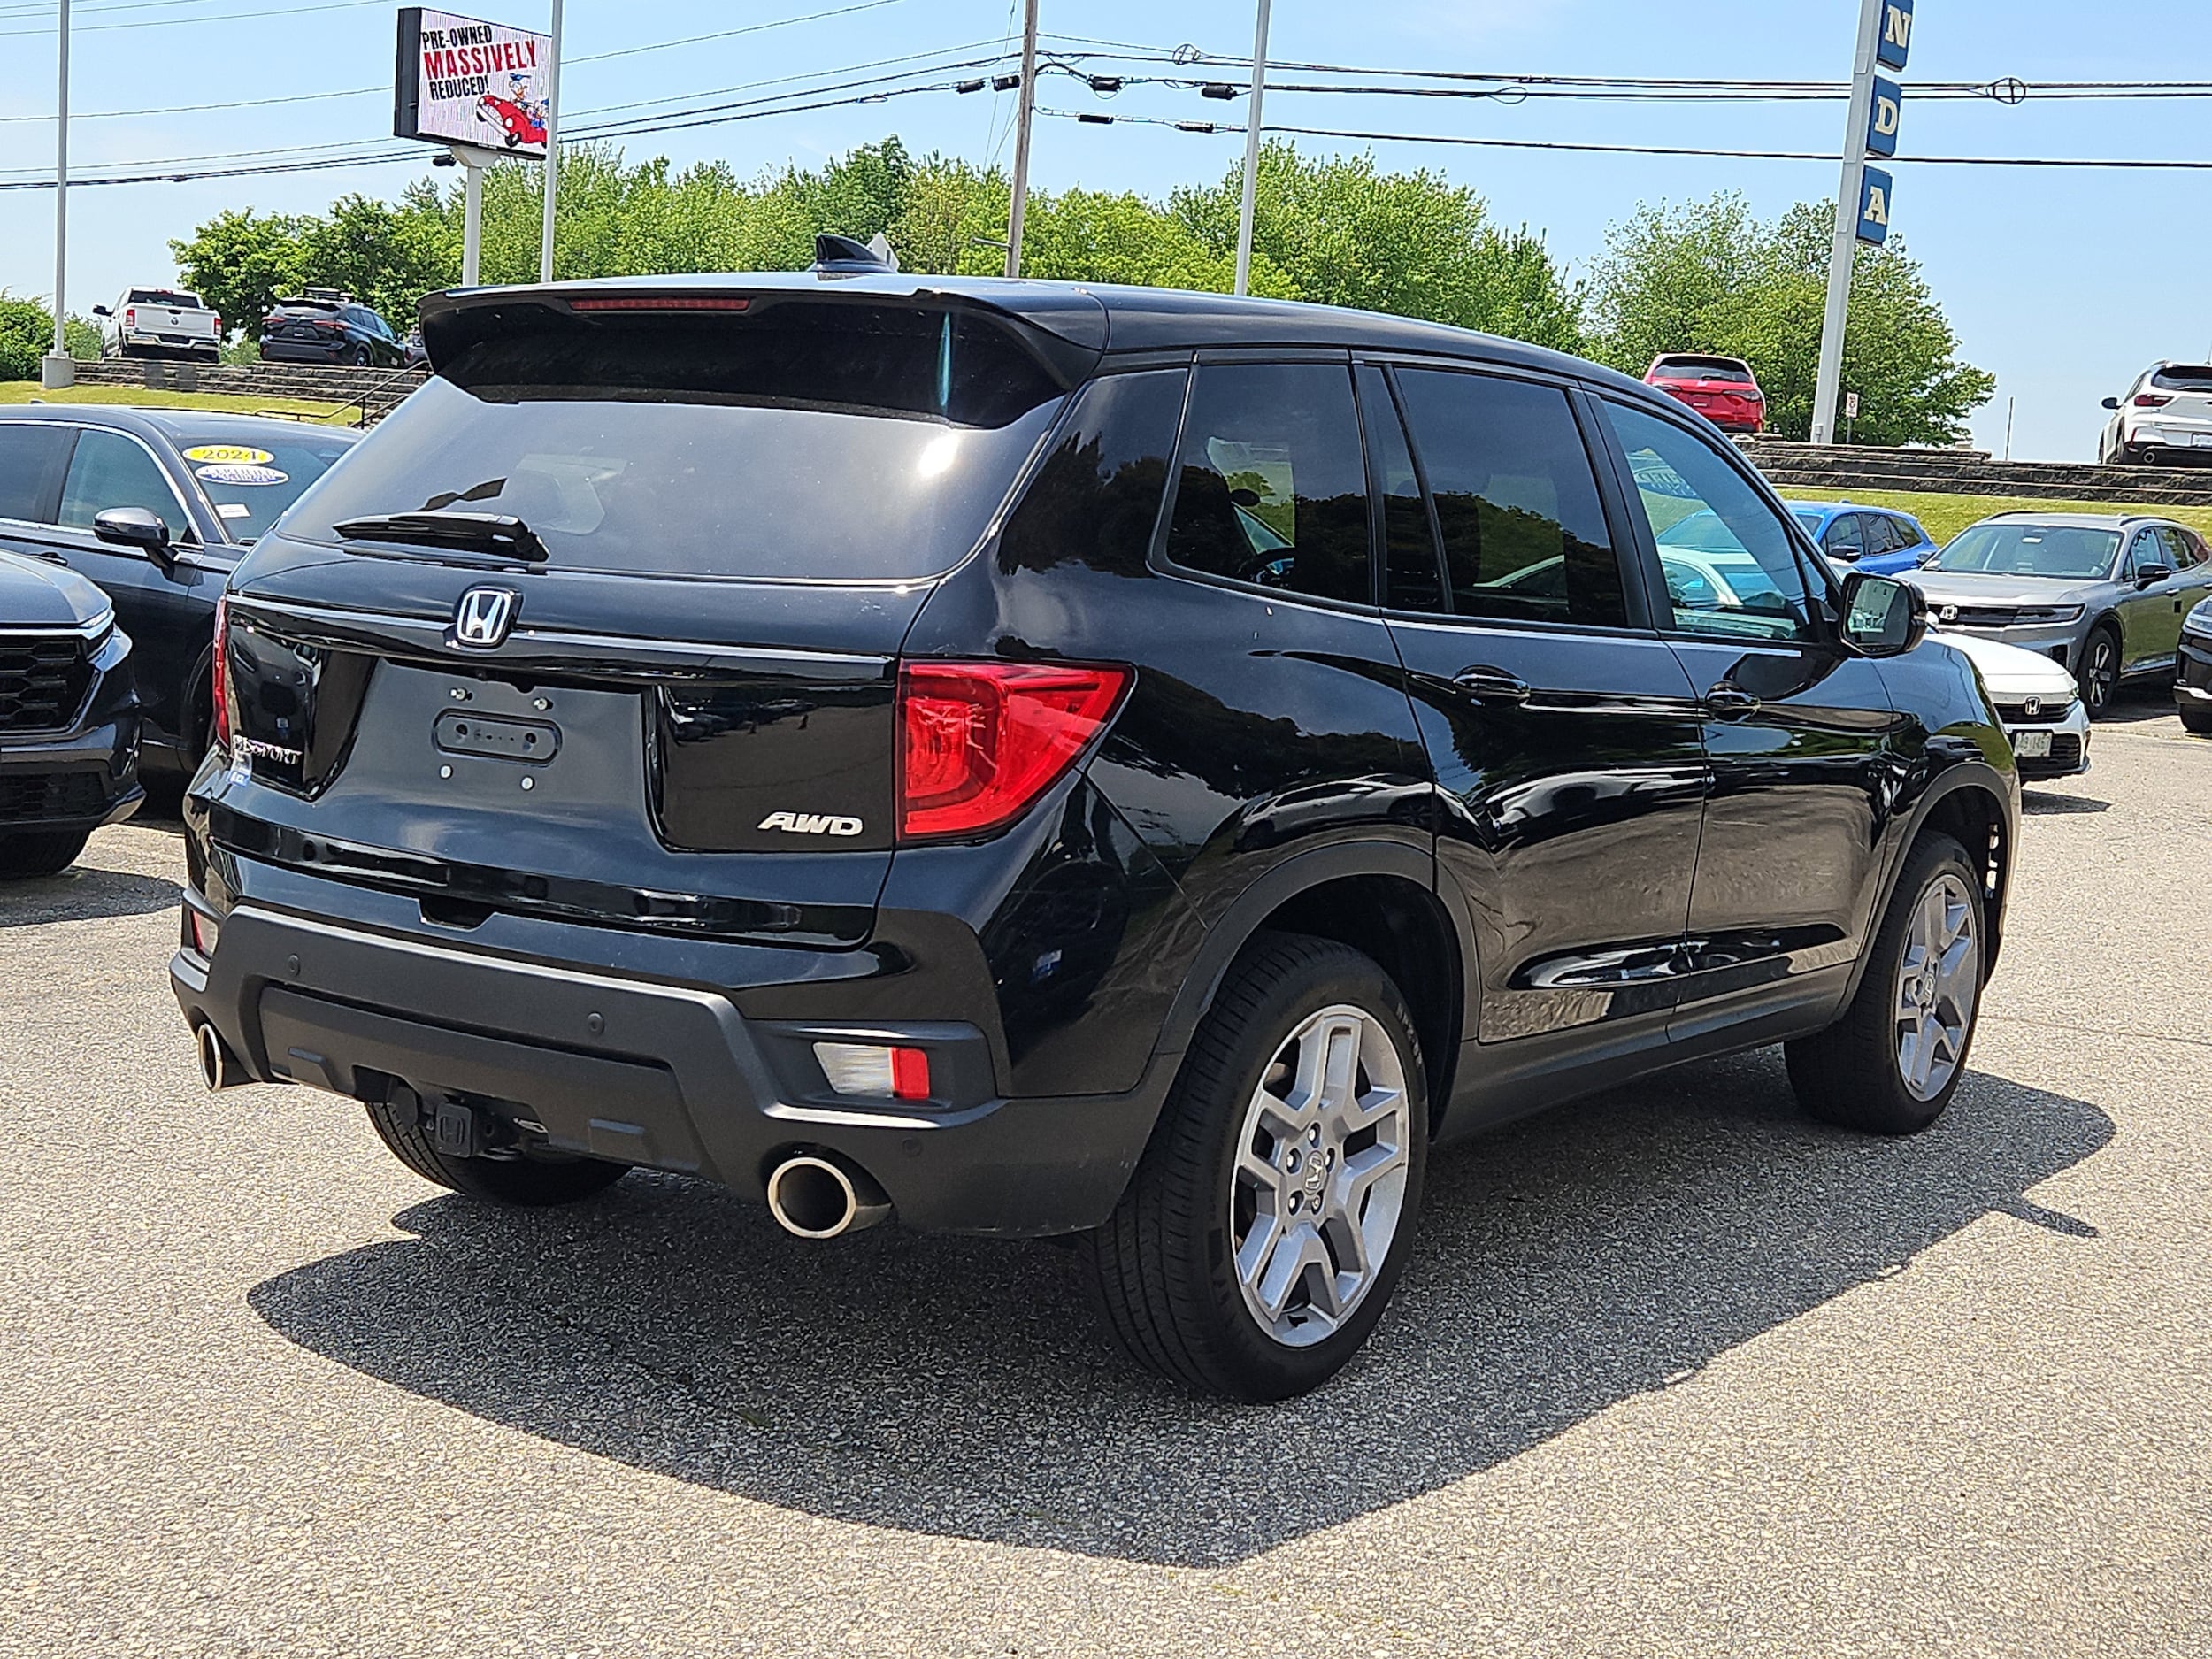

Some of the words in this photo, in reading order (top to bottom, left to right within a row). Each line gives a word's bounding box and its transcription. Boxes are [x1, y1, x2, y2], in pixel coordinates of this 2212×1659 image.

[422, 25, 492, 50] PRE-OWNED
[424, 41, 536, 80] MASSIVELY
[430, 75, 490, 100] REDUCED!
[757, 811, 864, 836] AWD
